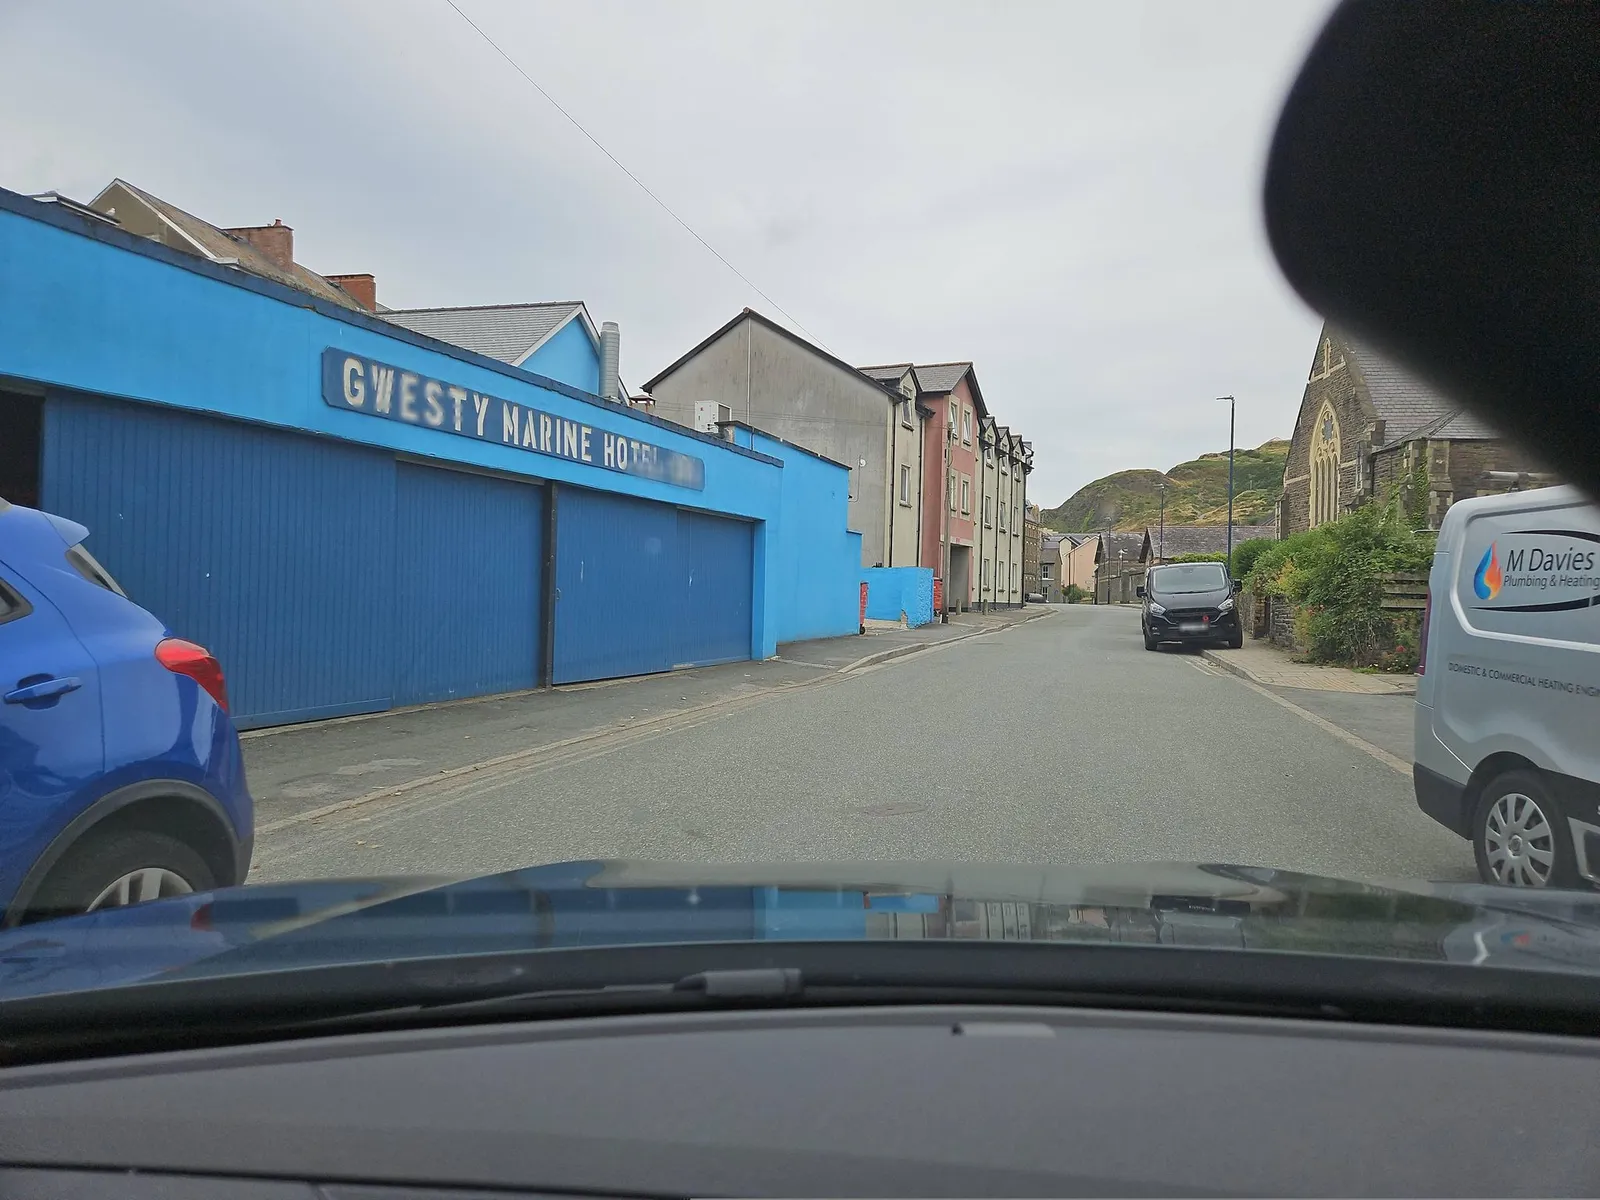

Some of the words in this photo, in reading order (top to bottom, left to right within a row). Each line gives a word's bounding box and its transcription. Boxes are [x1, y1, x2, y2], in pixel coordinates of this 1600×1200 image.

[343, 357, 489, 436] GWESTY
[503, 401, 592, 462] MARINE
[1506, 549, 1524, 572] M
[1528, 547, 1595, 572] Davies
[1503, 575, 1548, 590] Plumbing
[1549, 574, 1557, 587] &
[1559, 575, 1600, 590] Heating
[1448, 662, 1481, 677] DOMESTIC
[1481, 668, 1487, 678] &
[1488, 669, 1536, 687] COMMERCIAL
[1538, 678, 1573, 693] HEATING
